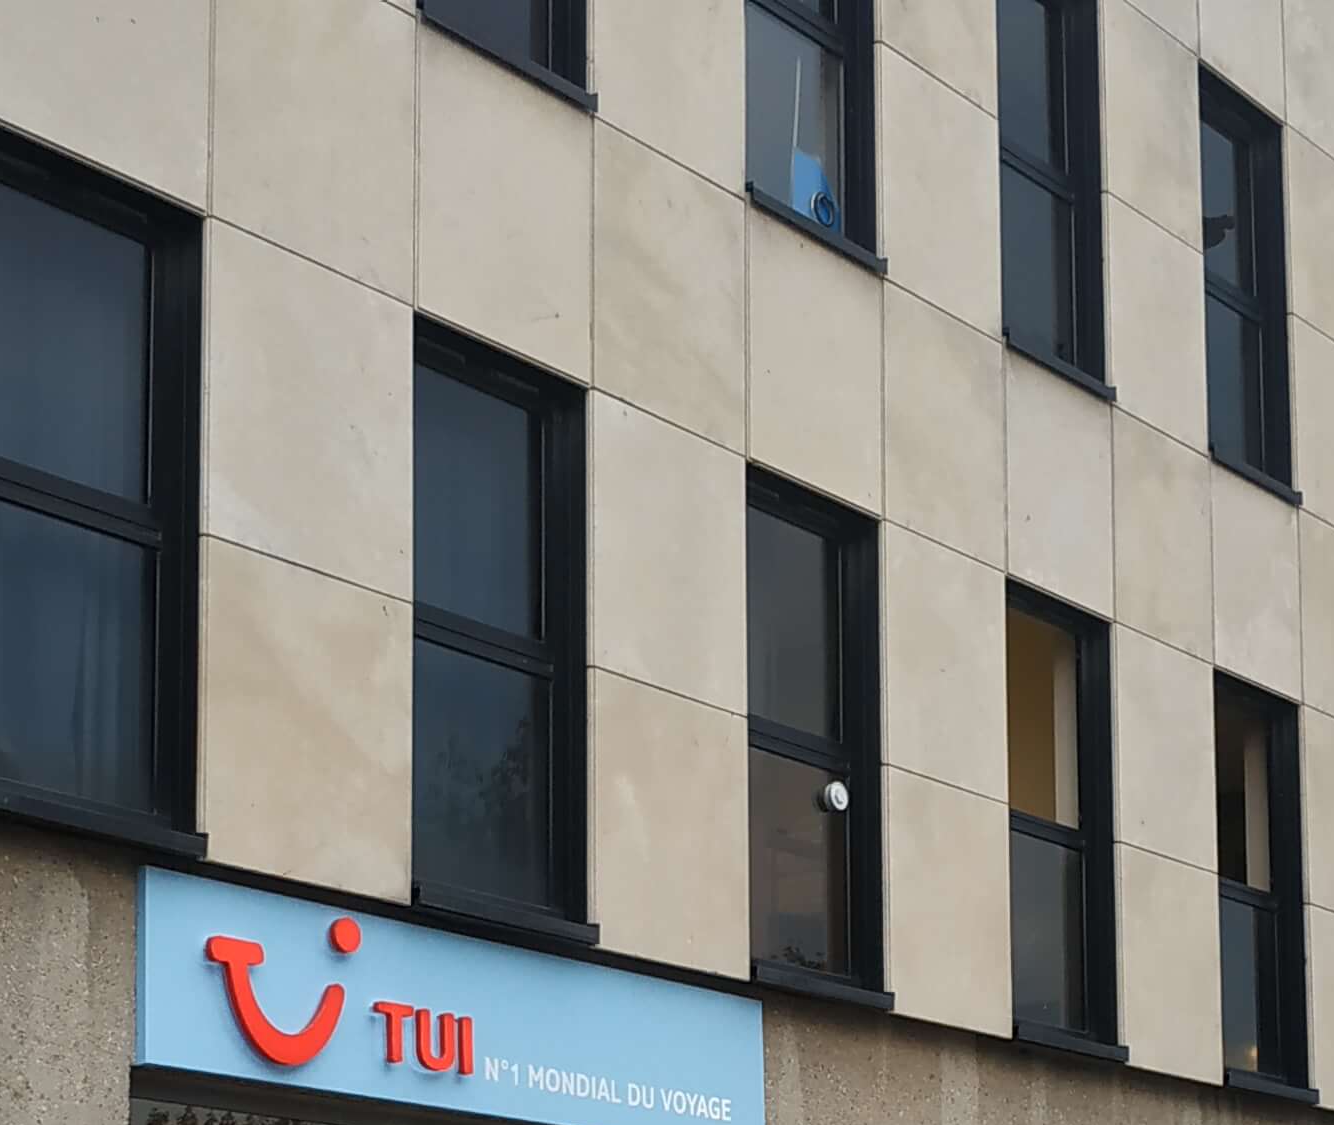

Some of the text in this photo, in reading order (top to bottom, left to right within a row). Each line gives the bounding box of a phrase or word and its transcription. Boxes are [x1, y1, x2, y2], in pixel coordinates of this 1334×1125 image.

[372, 1000, 473, 1075] TUI
[484, 1056, 732, 1121] N°1 MONDIAL DU VOYAGE
